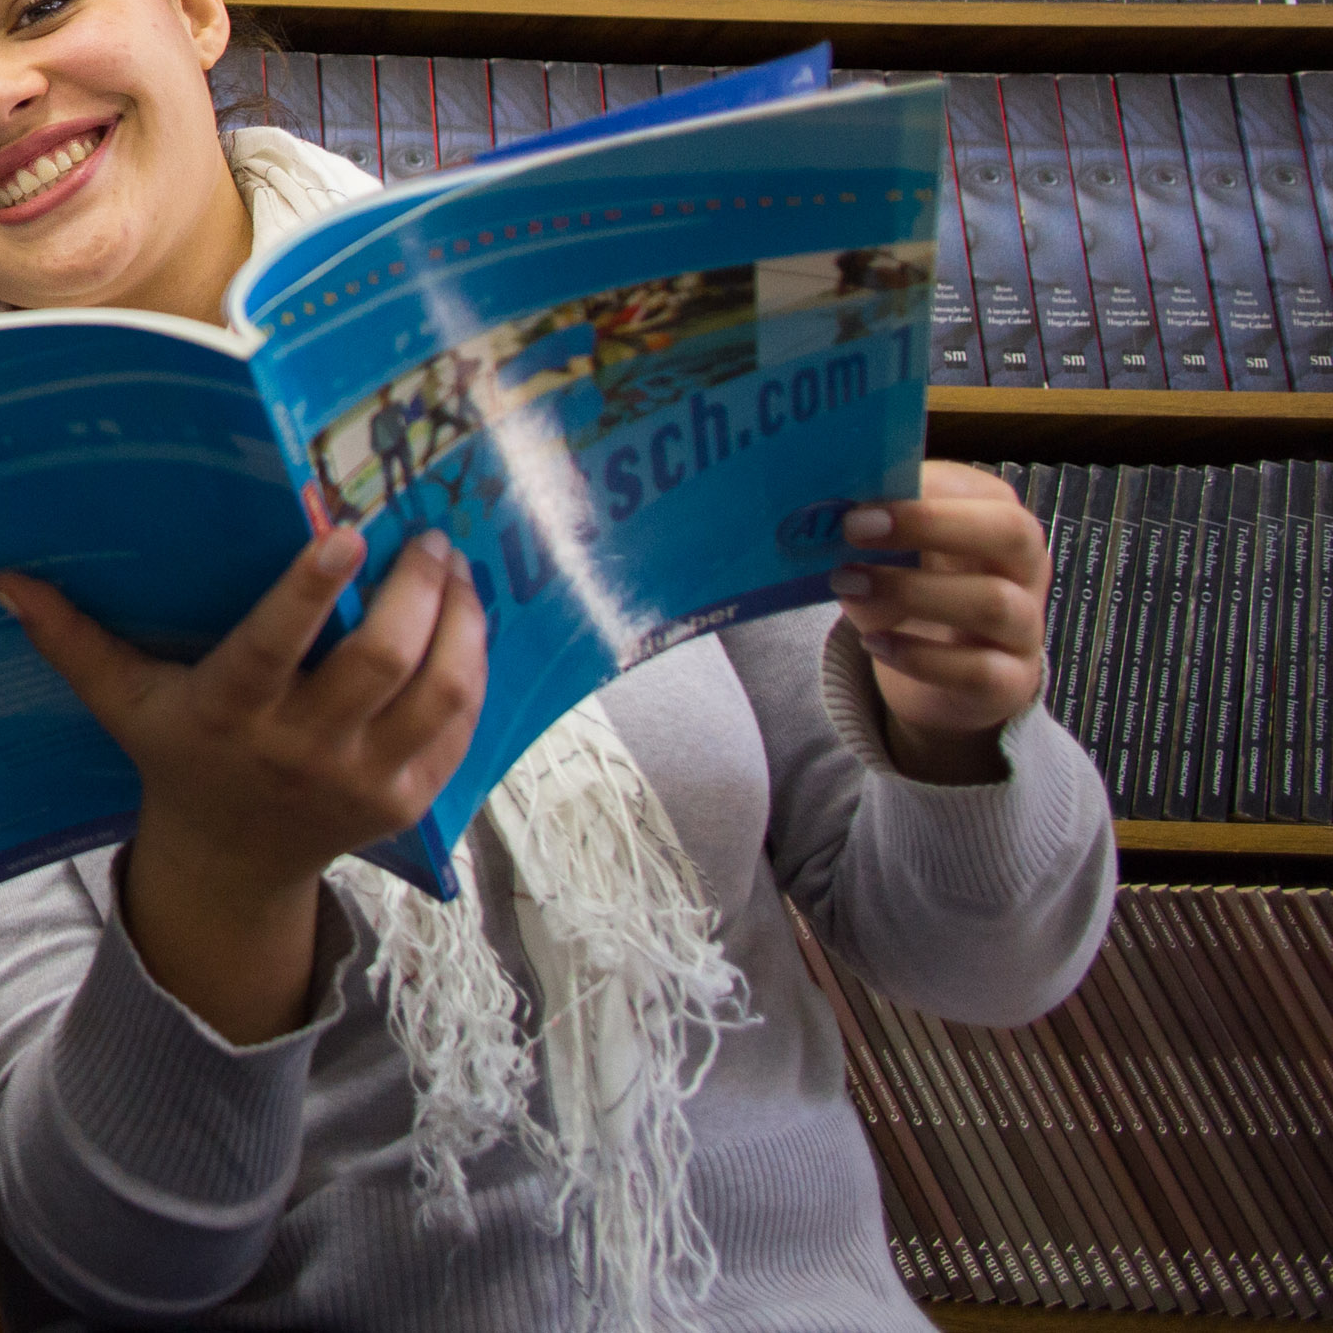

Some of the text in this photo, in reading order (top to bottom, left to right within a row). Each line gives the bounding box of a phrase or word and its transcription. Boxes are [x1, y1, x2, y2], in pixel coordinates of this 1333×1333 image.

[944, 349, 967, 362] sm
[1063, 353, 1085, 366] sm
[1233, 526, 1249, 577] Tchekhov
[1294, 524, 1308, 574] Tchekhov
[1224, 603, 1239, 654] assassinato
[1288, 600, 1301, 652] assassinato
[1220, 666, 1233, 698] outras
[1287, 665, 1298, 696] outras
[1216, 700, 1231, 743] histórias
[1285, 698, 1298, 742] histórias
